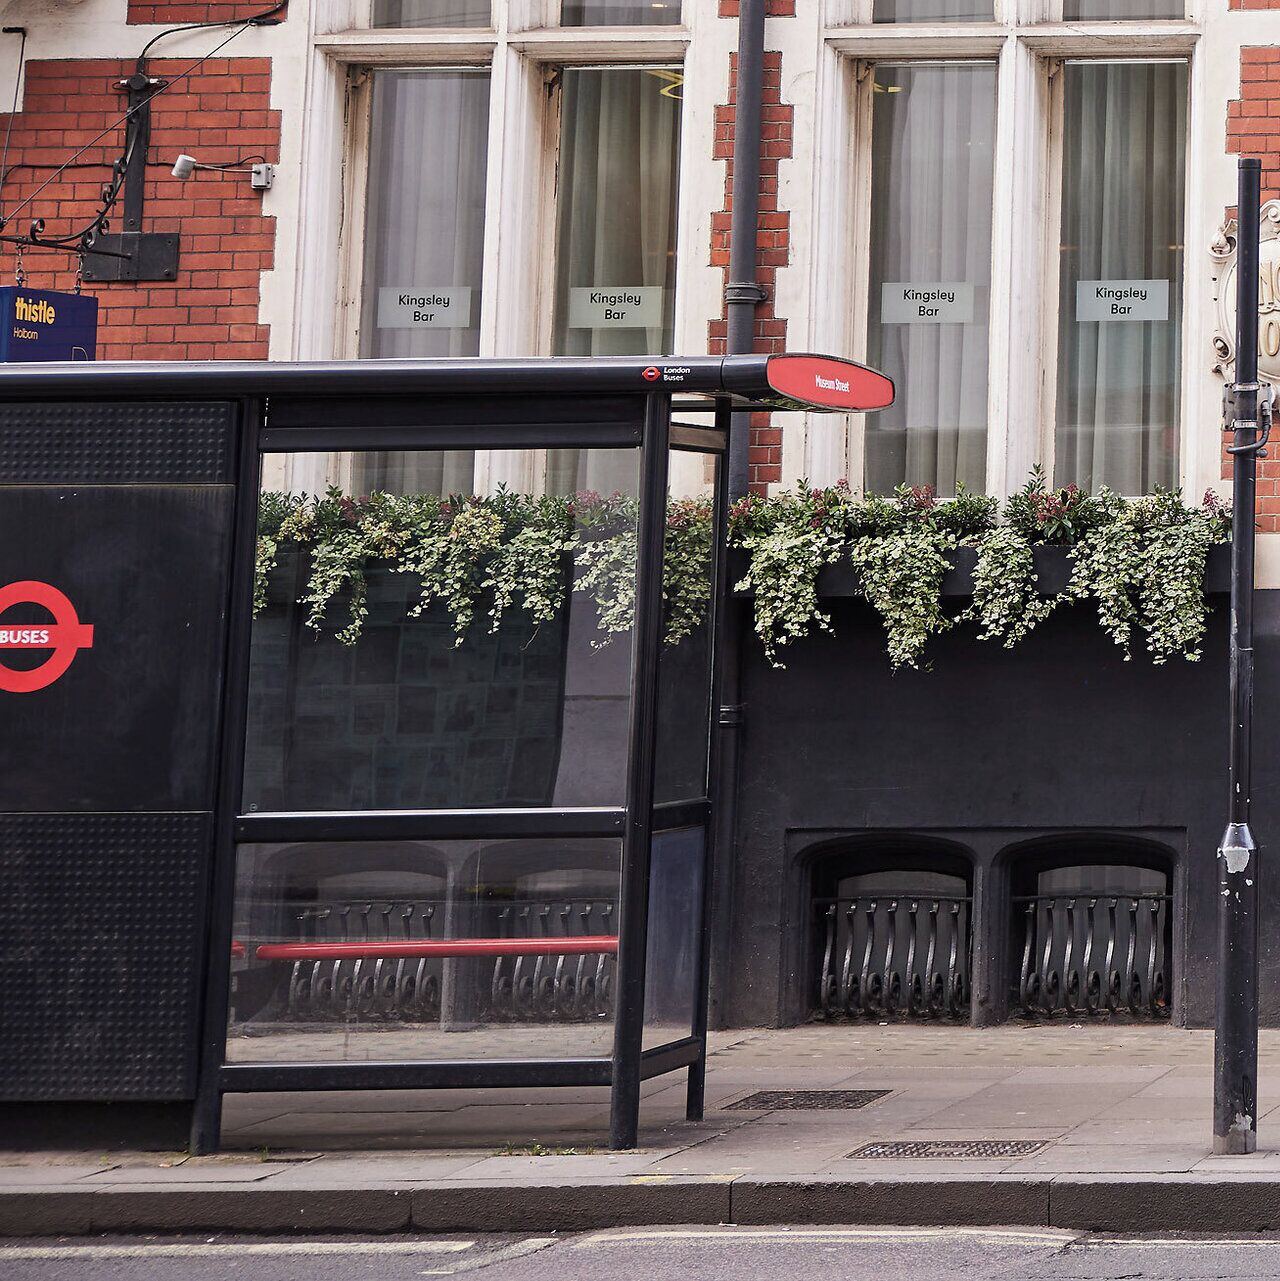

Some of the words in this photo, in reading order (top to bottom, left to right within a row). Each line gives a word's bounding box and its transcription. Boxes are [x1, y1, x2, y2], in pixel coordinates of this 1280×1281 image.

[590, 292, 642, 307] Kingsley
[903, 288, 956, 303] Kingsley
[1095, 286, 1148, 301] Kingsley
[398, 294, 451, 309] Kingsley
[1110, 303, 1132, 315] Bar
[15, 296, 56, 325] thistle
[413, 311, 435, 323] Bar
[604, 309, 626, 321] Bar
[918, 306, 940, 317] Bar
[815, 374, 836, 390] Museum
[835, 378, 850, 393] Street
[0, 630, 49, 644] BUSES
